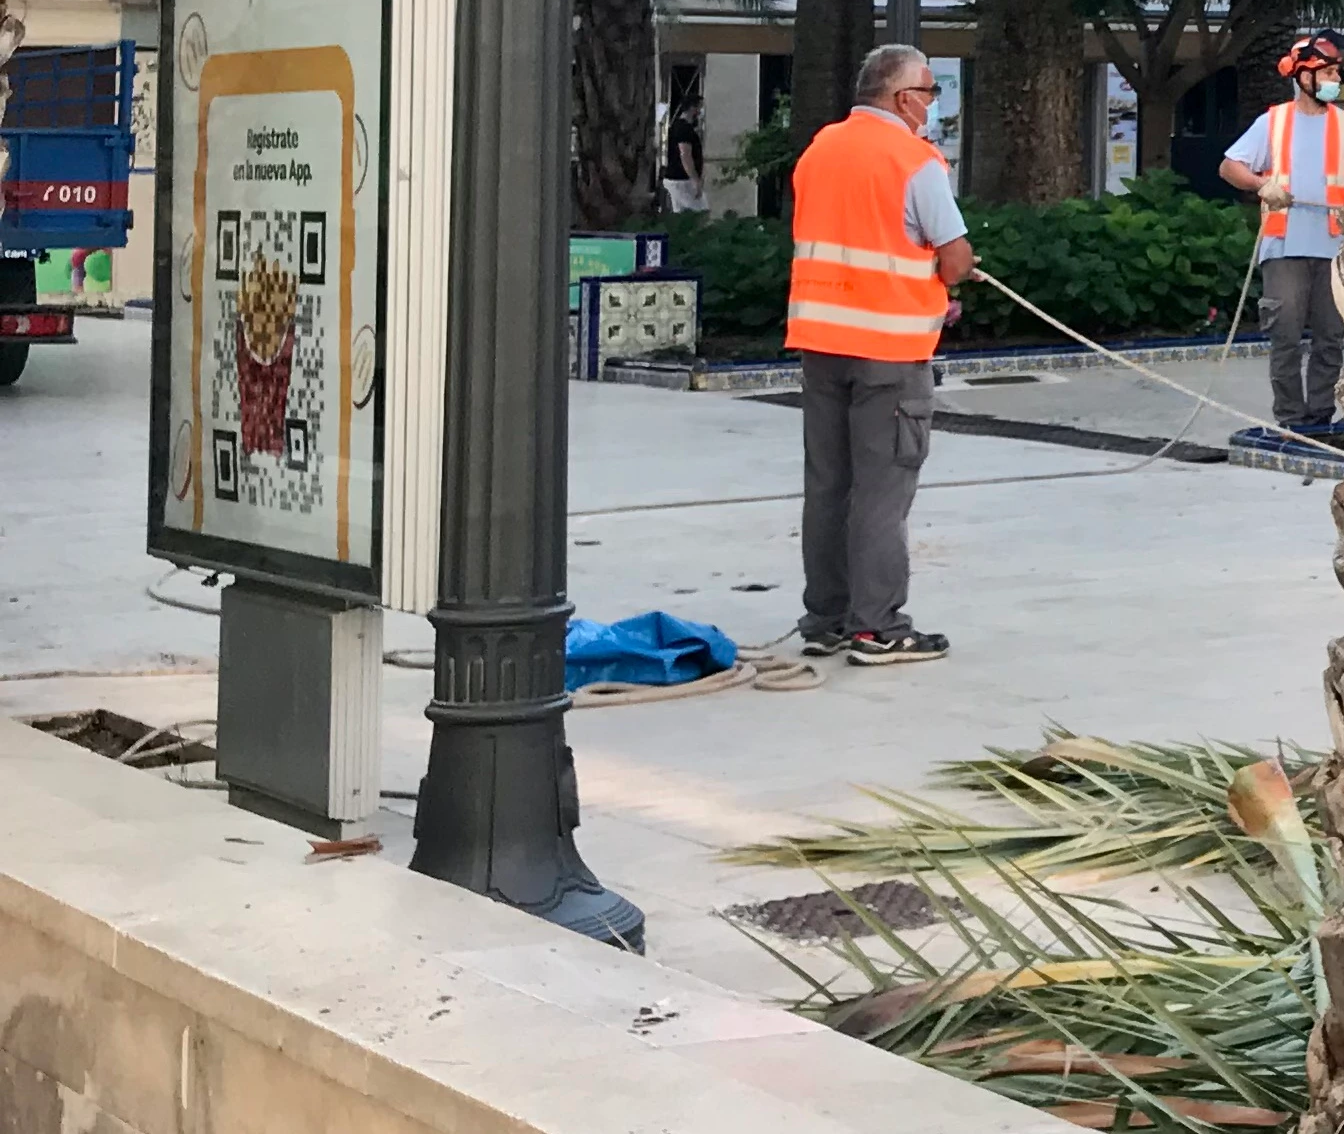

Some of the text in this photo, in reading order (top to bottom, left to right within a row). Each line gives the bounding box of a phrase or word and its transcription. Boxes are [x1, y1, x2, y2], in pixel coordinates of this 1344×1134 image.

[233, 164, 245, 181] en
[254, 164, 287, 181] nueva
[288, 157, 313, 187] App.
[59, 185, 97, 204] 010
